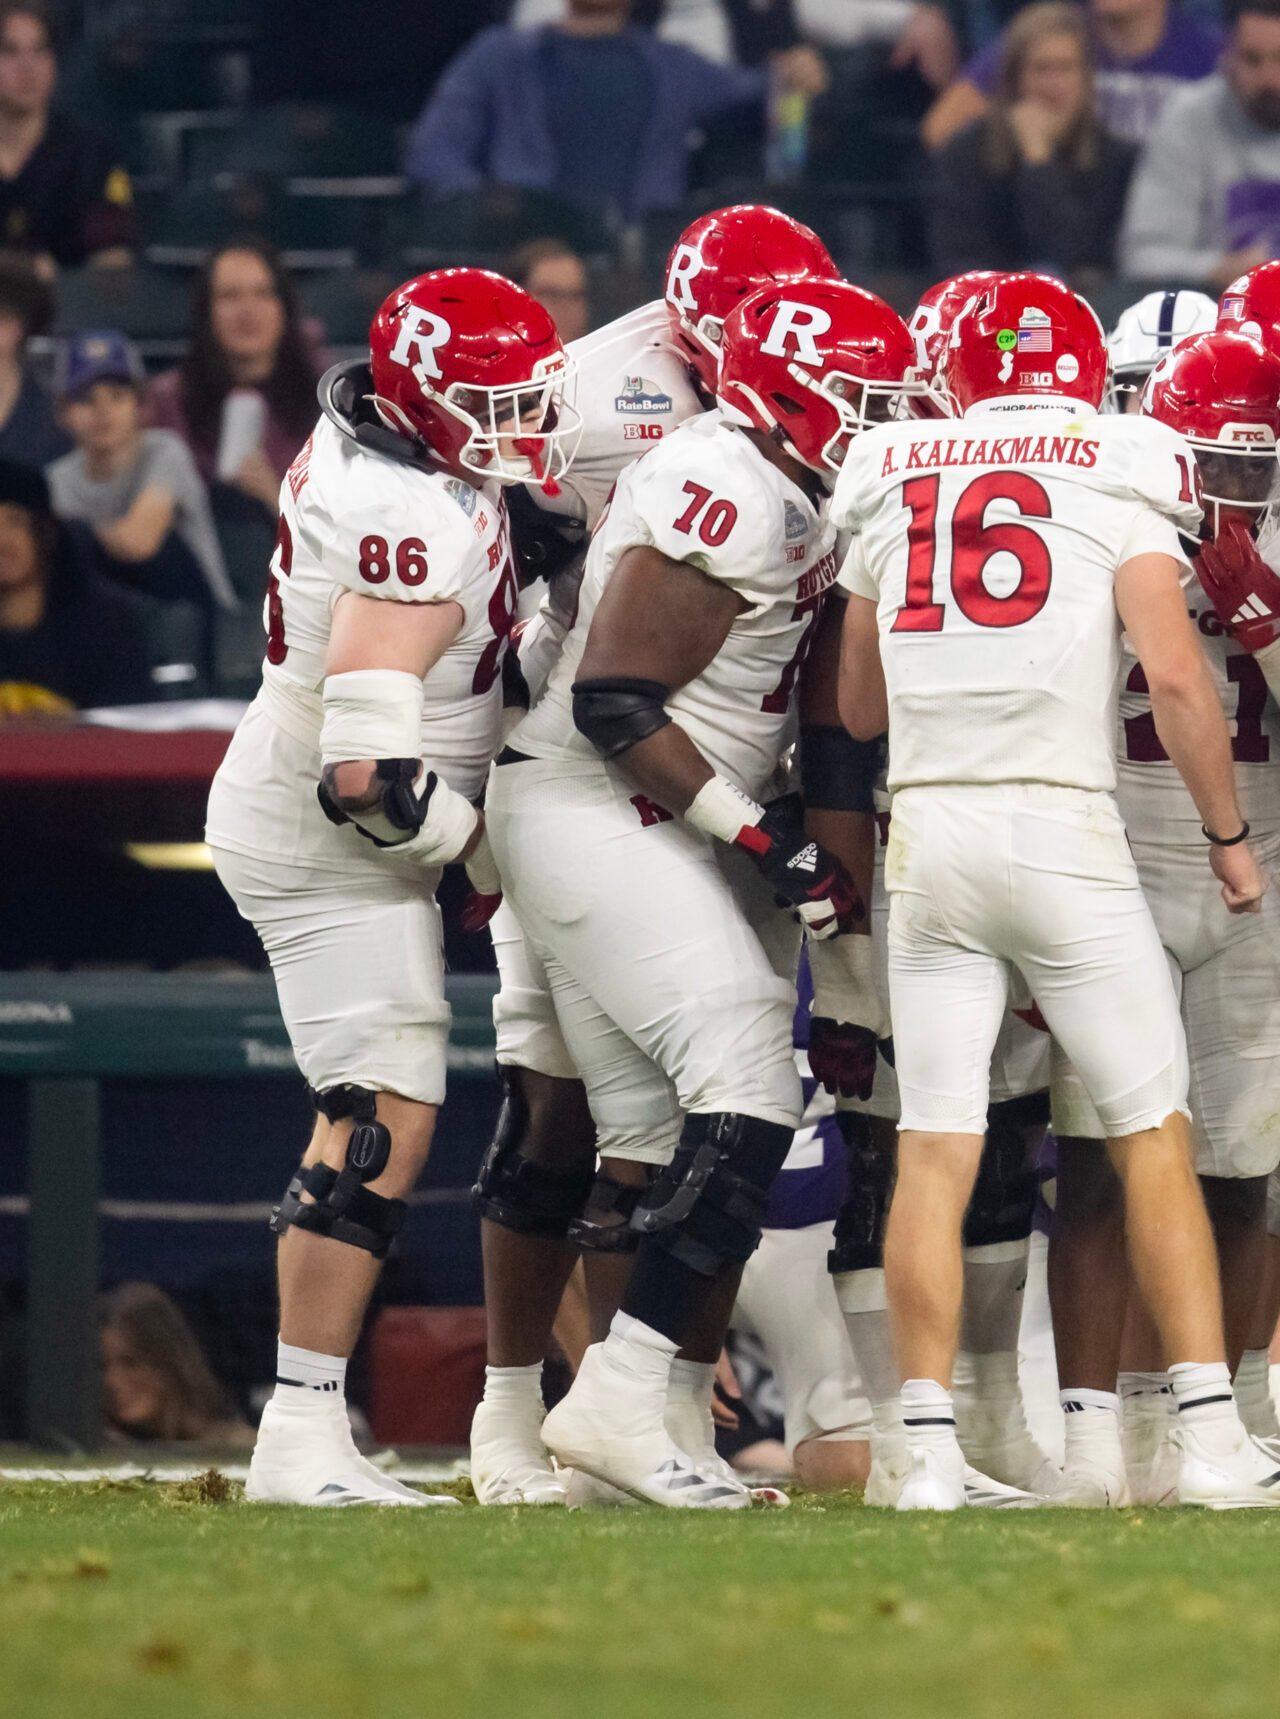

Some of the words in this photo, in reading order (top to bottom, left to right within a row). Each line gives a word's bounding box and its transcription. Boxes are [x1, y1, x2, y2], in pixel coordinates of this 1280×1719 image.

[389, 304, 451, 380] R
[760, 300, 832, 368] R
[881, 446, 899, 478] A.
[905, 436, 1100, 469] KALIAKMANIS
[672, 480, 738, 547] 70
[358, 535, 428, 587] 86
[889, 469, 1053, 633] 16
[786, 842, 818, 869] adidas
